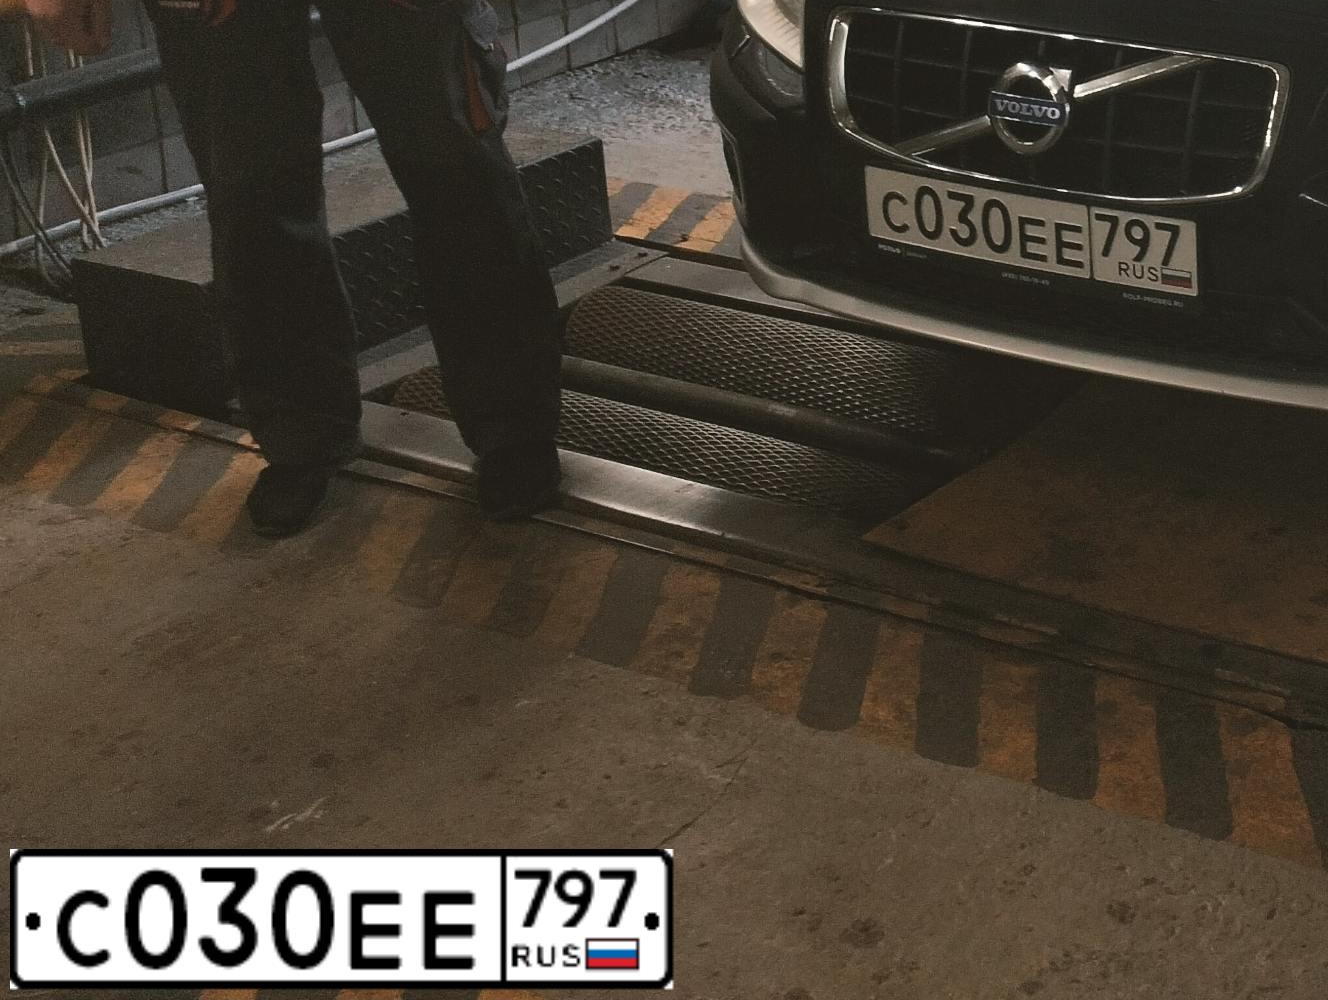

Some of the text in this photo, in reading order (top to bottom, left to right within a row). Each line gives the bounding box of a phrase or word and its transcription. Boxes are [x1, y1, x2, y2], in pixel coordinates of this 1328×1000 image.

[994, 99, 1060, 119] VOLVO
[1094, 213, 1181, 267] 797
[1118, 261, 1159, 282] RUS
